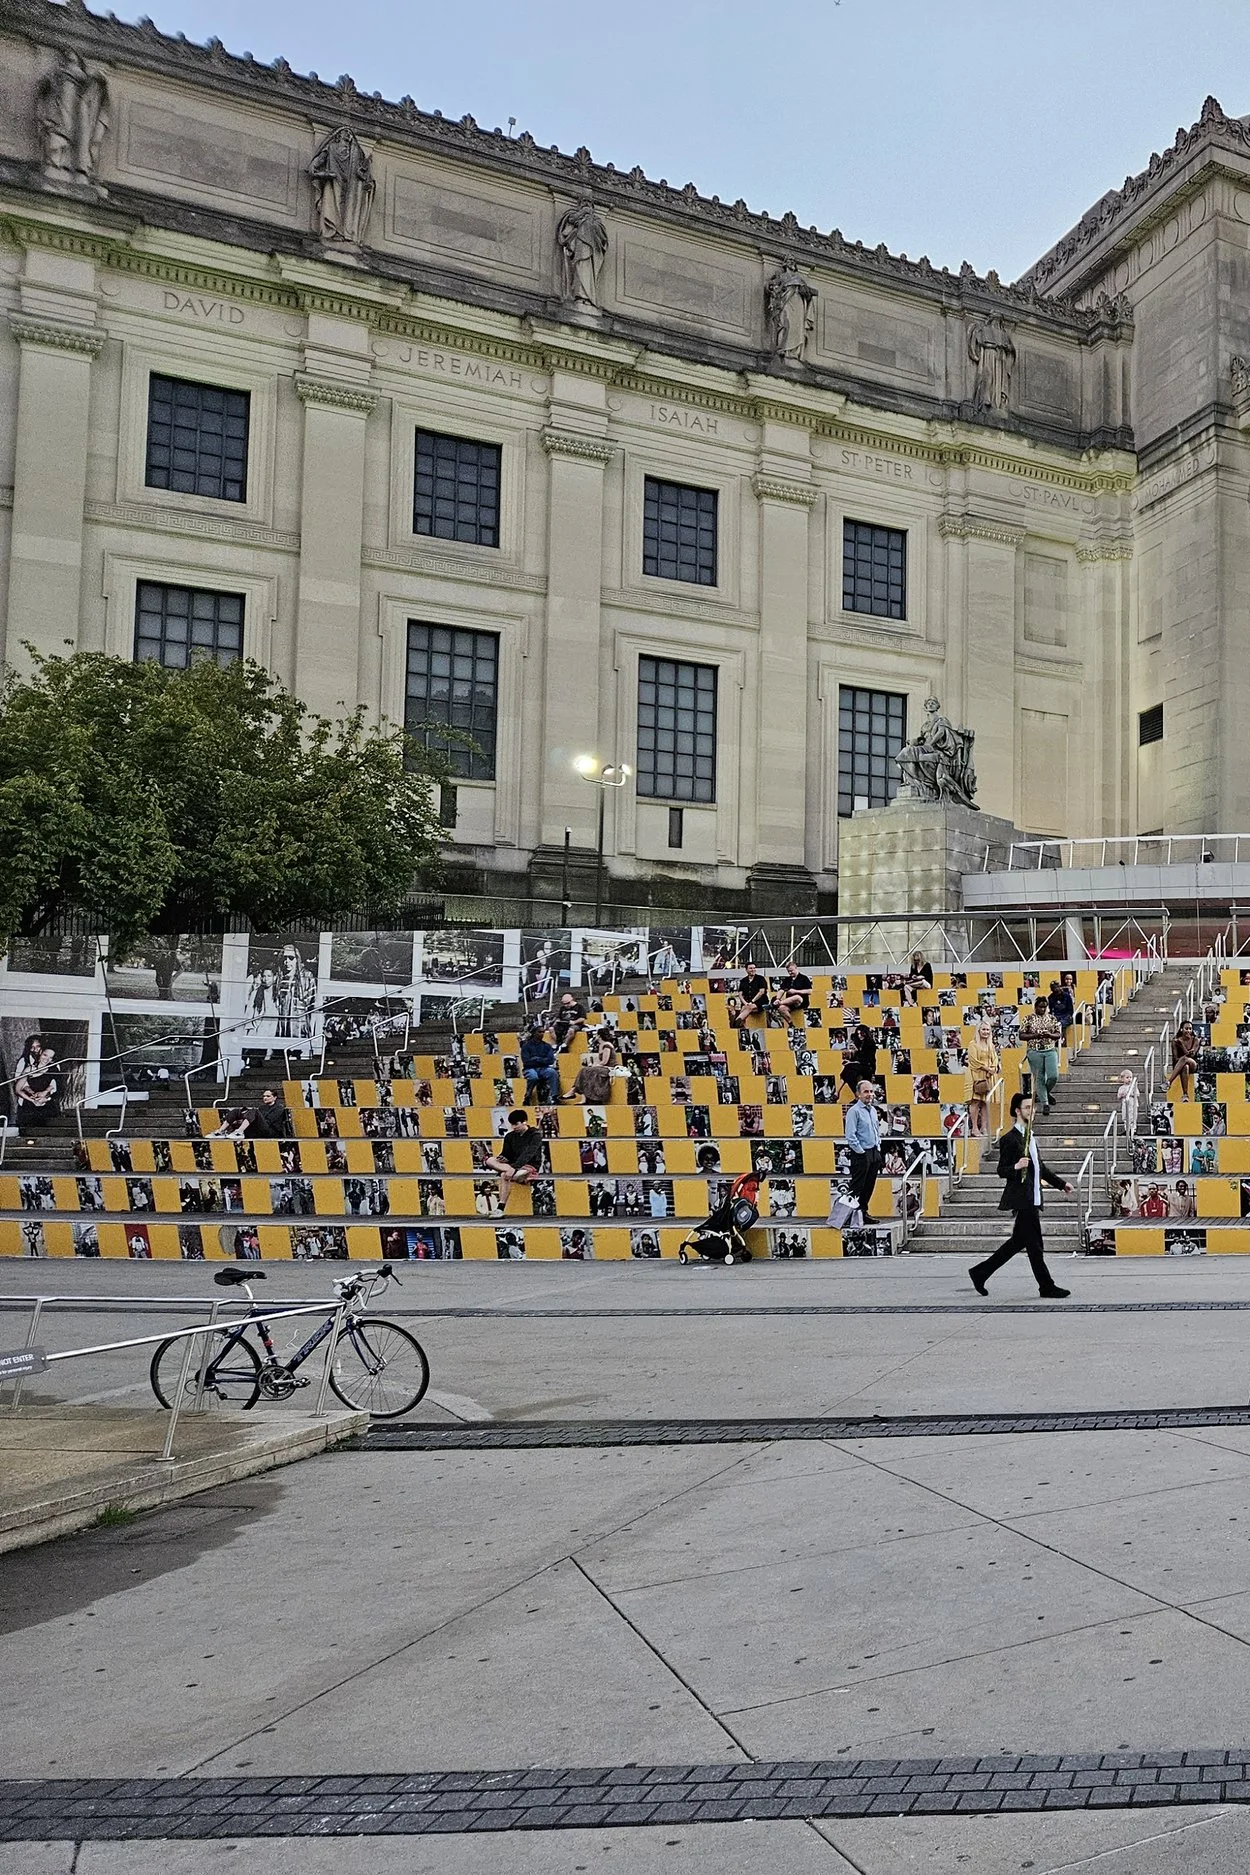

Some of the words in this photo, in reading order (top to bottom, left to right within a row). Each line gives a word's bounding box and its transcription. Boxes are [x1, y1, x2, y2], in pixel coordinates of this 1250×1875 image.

[163, 291, 245, 324] DAVID
[399, 347, 523, 389] JEREMIAH
[650, 404, 719, 434] ISAIAH
[293, 1320, 332, 1362] TREK
[12, 1353, 35, 1363] ENTER
